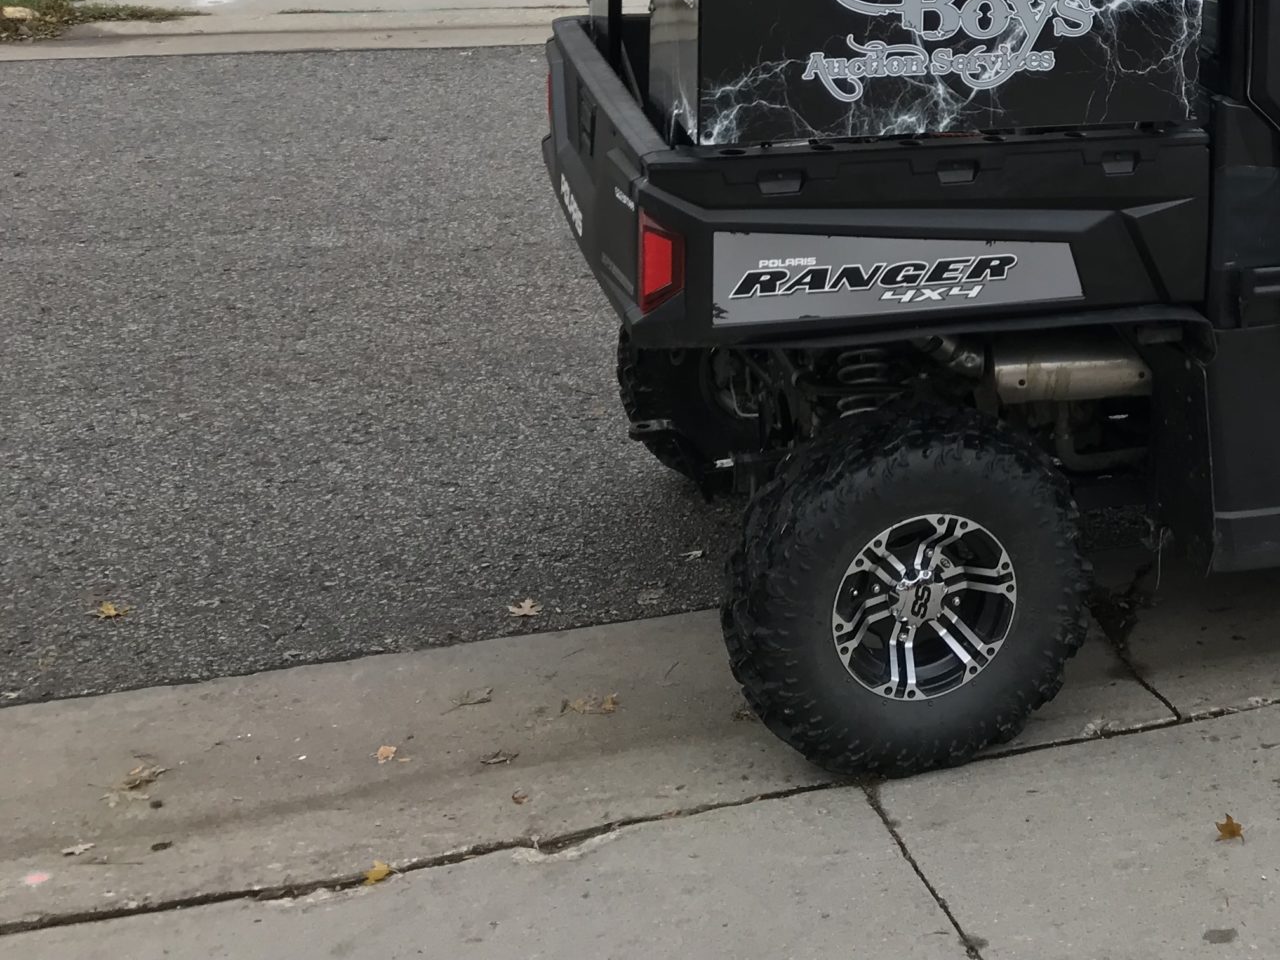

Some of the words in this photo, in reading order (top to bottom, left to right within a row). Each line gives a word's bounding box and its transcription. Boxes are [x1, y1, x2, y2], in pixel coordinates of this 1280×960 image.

[802, 34, 931, 101] Auction
[729, 253, 1018, 299] RANGER
[759, 257, 816, 268] POLARIS
